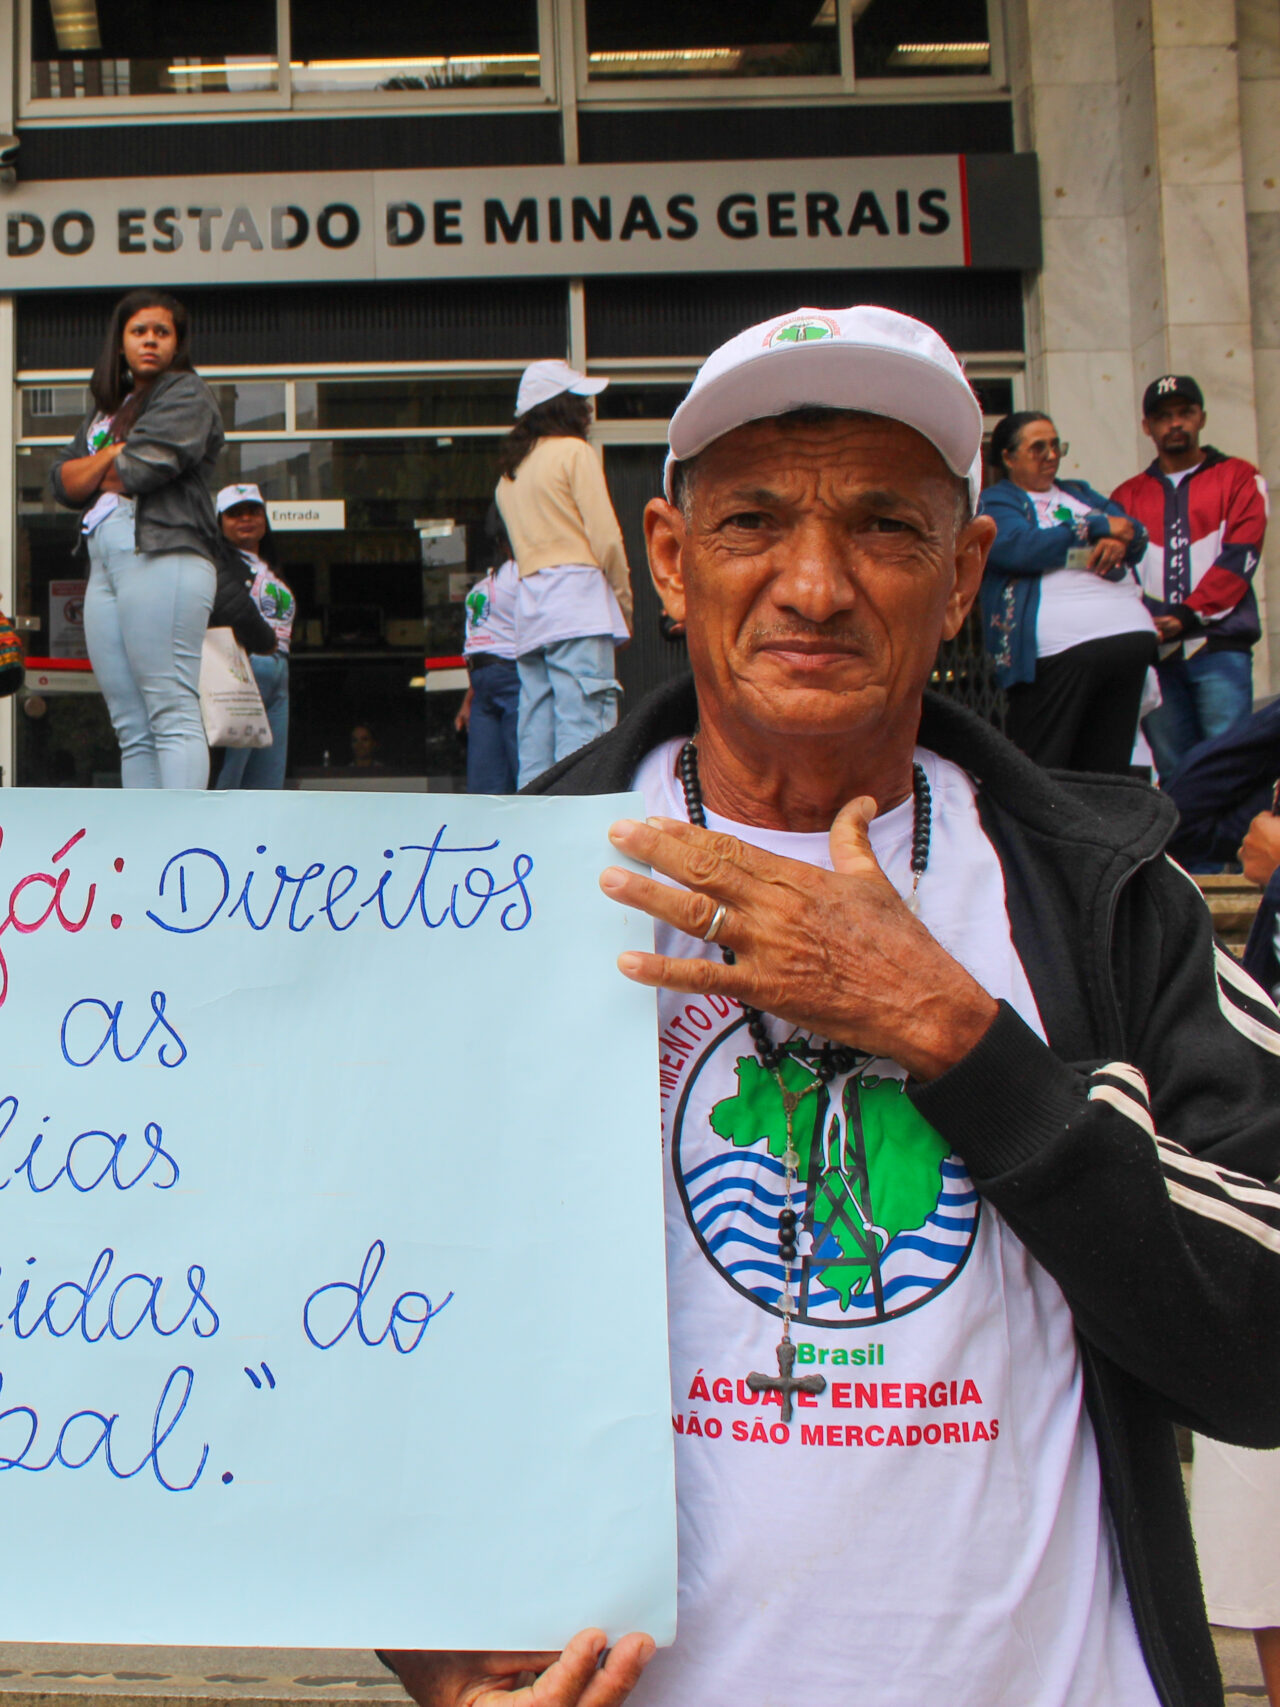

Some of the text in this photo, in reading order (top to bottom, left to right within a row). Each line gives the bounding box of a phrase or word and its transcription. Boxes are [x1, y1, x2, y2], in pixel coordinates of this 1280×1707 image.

[6, 210, 95, 257] DO
[117, 203, 361, 254] ESTADO
[385, 199, 464, 247] DE
[483, 192, 700, 245] MINAS
[716, 185, 953, 241] GERAIS
[271, 508, 321, 521] Entrada
[146, 824, 534, 934] Direitos
[60, 991, 188, 1068] as
[303, 1239, 455, 1354] do
[796, 1343, 884, 1365] Brasil
[831, 1378, 984, 1409] ENERGIA
[731, 1416, 791, 1446] SÃO
[800, 1418, 1000, 1448] MERCADORIAS
